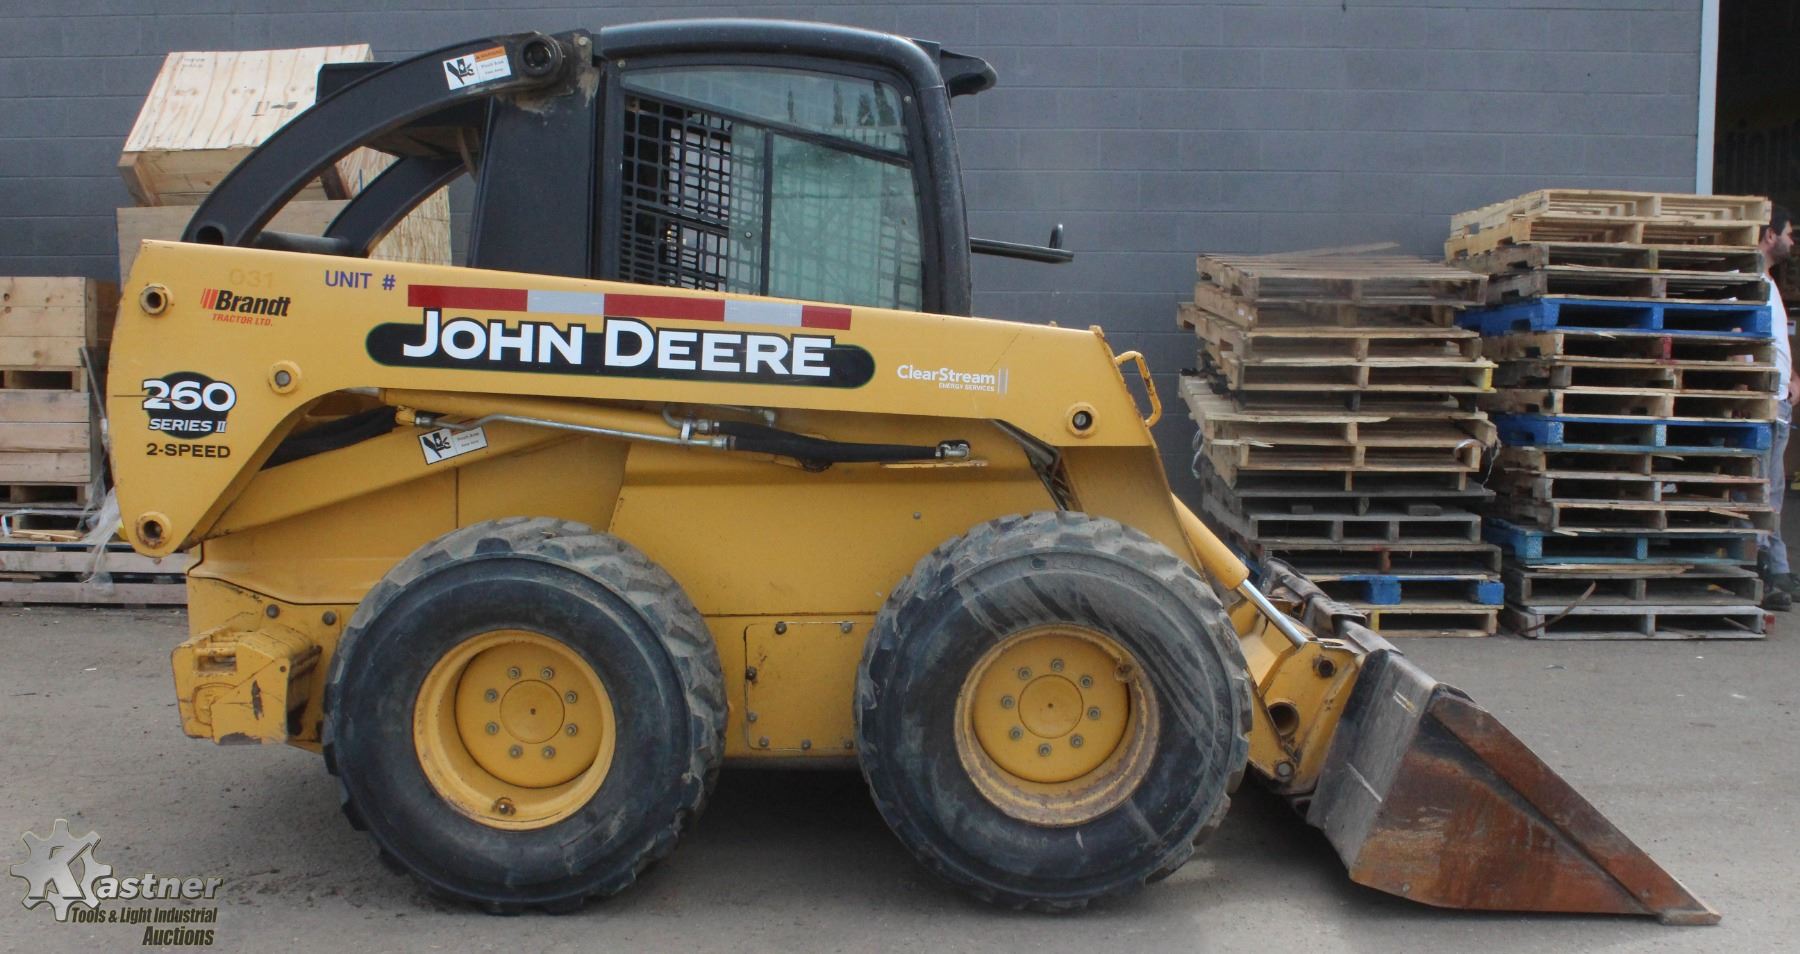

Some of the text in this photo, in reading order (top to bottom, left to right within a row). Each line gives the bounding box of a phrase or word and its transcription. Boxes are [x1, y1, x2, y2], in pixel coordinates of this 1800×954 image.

[325, 270, 396, 291] UNIT #
[215, 289, 291, 317] Brandt
[212, 313, 274, 327] TRACTOR LTD.
[403, 309, 833, 377] JOHN DEERE
[896, 364, 995, 384] ClearStream
[142, 379, 237, 411] 260
[148, 418, 213, 433] SERIES
[146, 442, 231, 459] 2-SPEED
